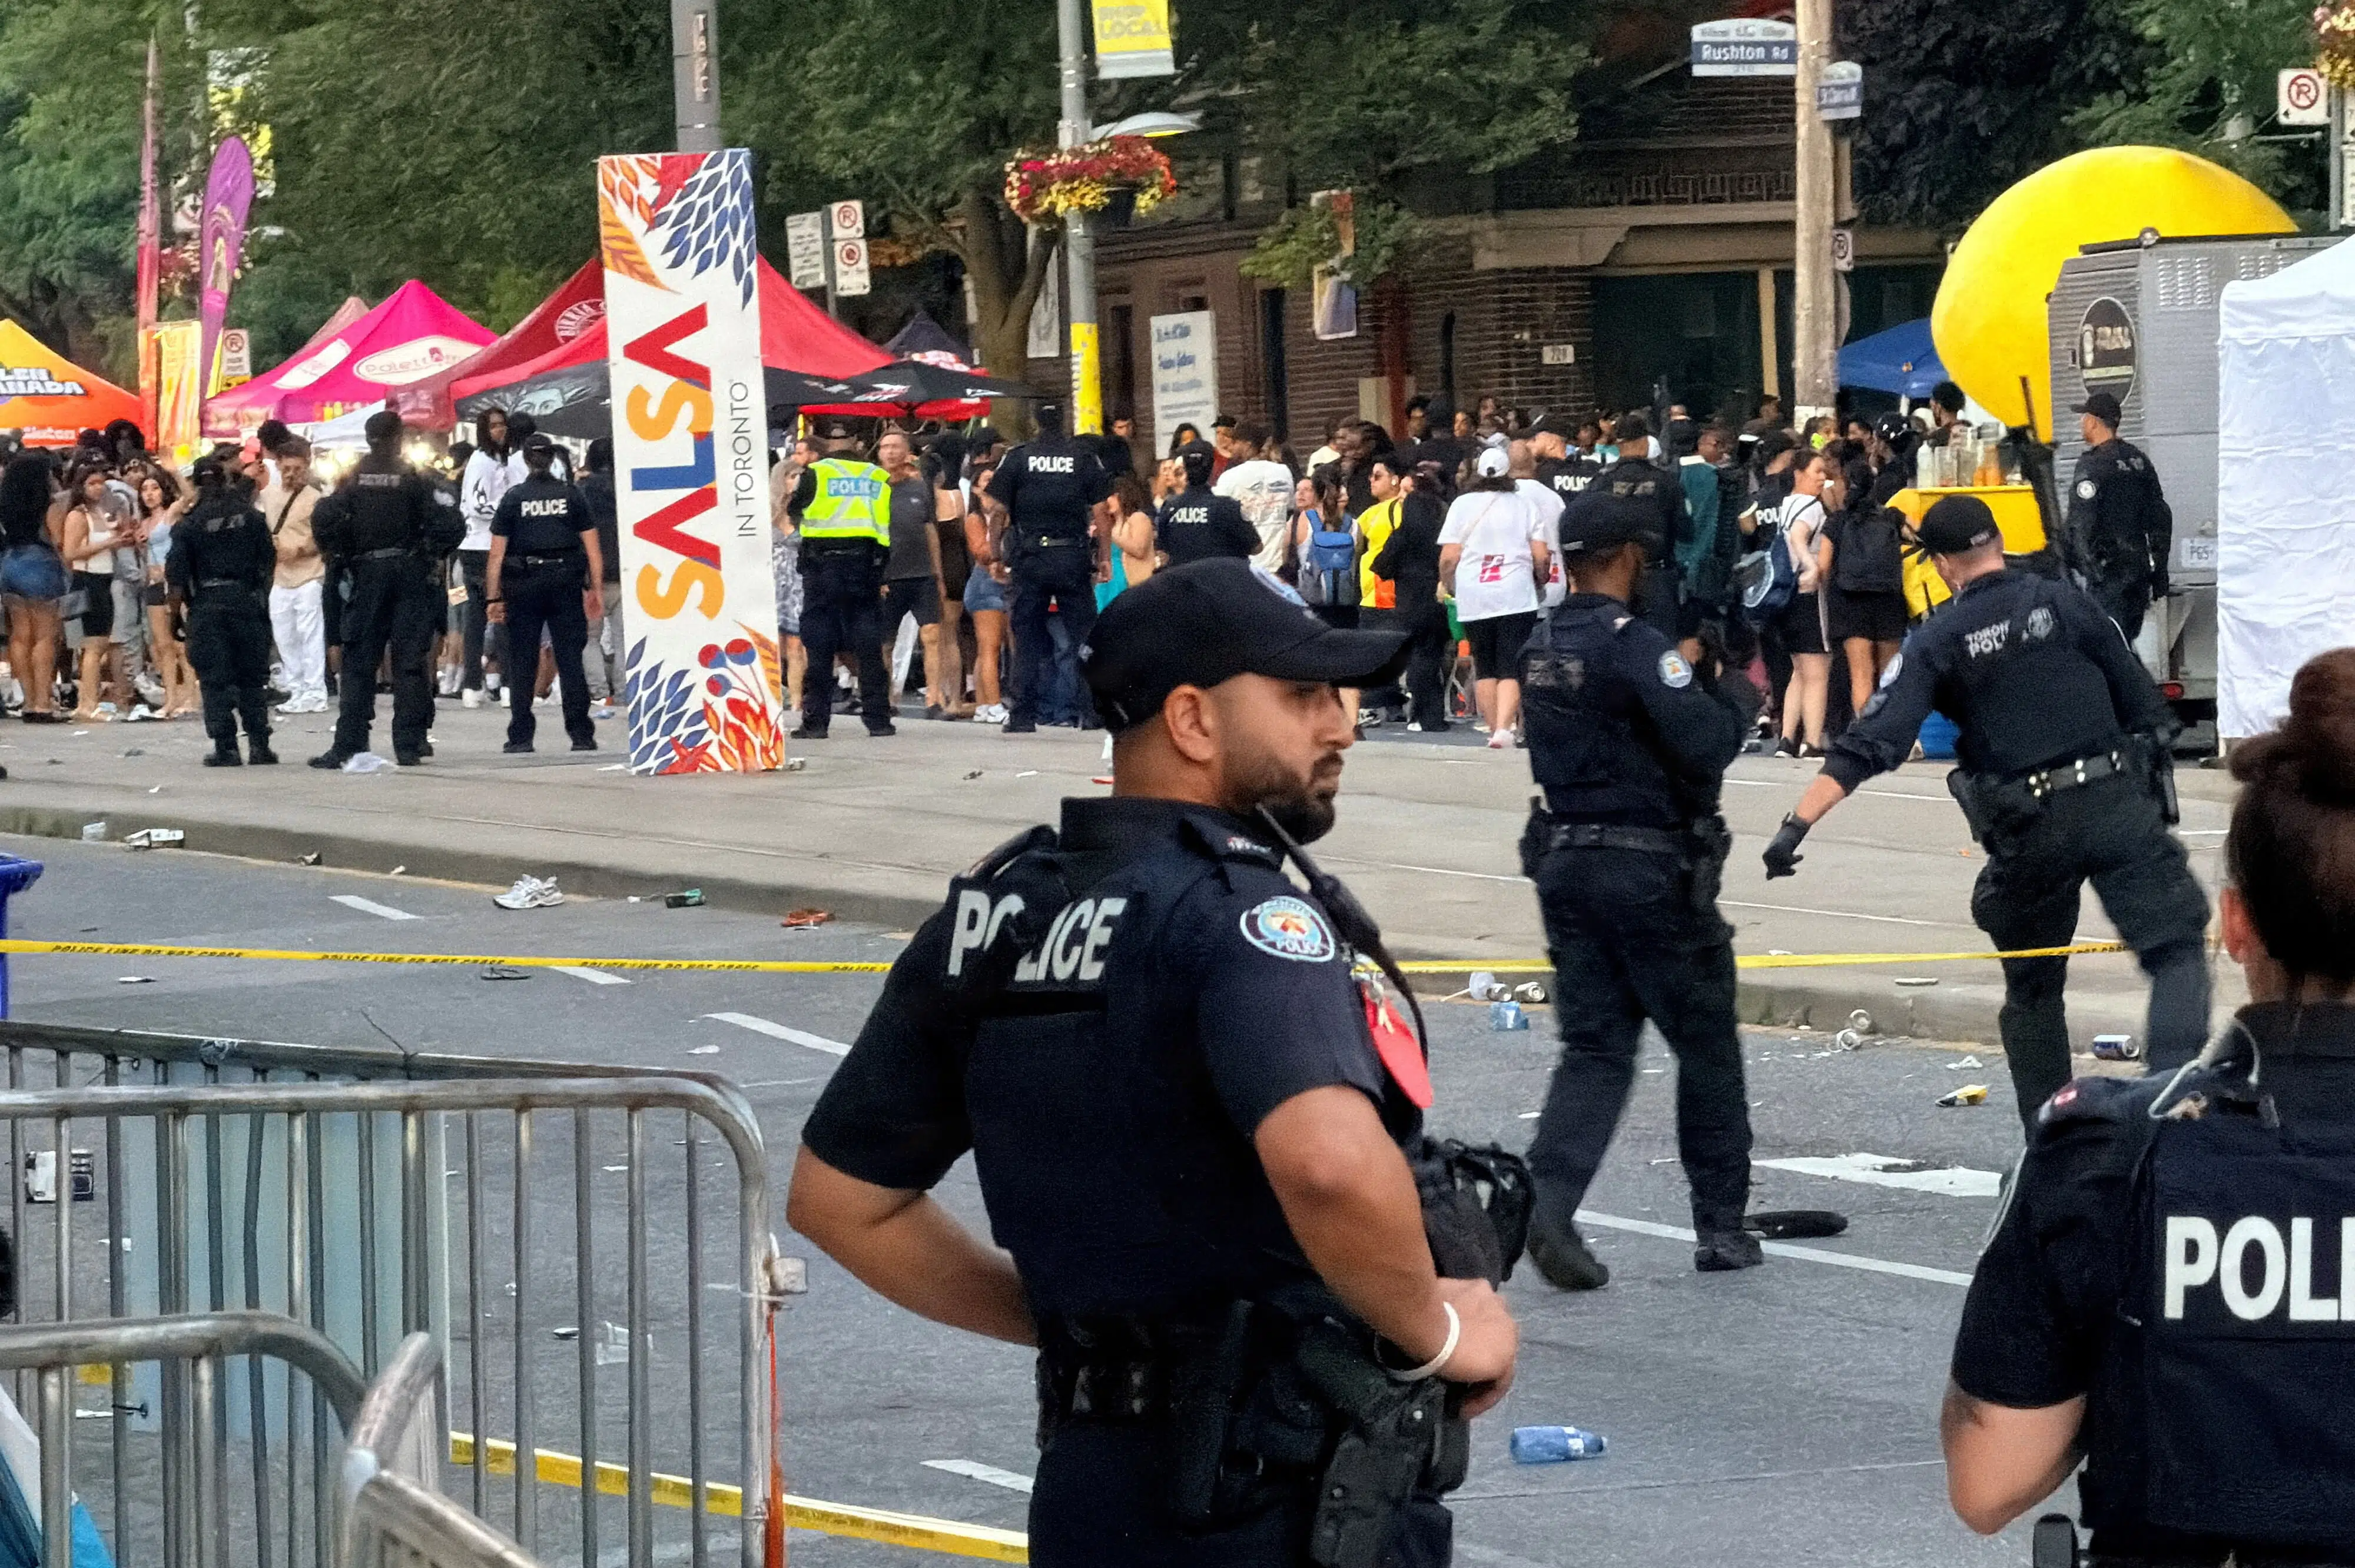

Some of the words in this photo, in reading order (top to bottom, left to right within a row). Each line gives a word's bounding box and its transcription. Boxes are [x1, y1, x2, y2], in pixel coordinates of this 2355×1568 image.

[1701, 44, 1766, 61] Rushton
[1771, 46, 1789, 60] Rd
[729, 380, 754, 506] TORONTO
[623, 302, 725, 620] SALSA
[1028, 456, 1074, 473] POLICE
[521, 498, 568, 517] POLICE
[736, 513, 757, 537] IN
[52, 945, 103, 954] POLICE
[2164, 1215, 2355, 1321] POLI
